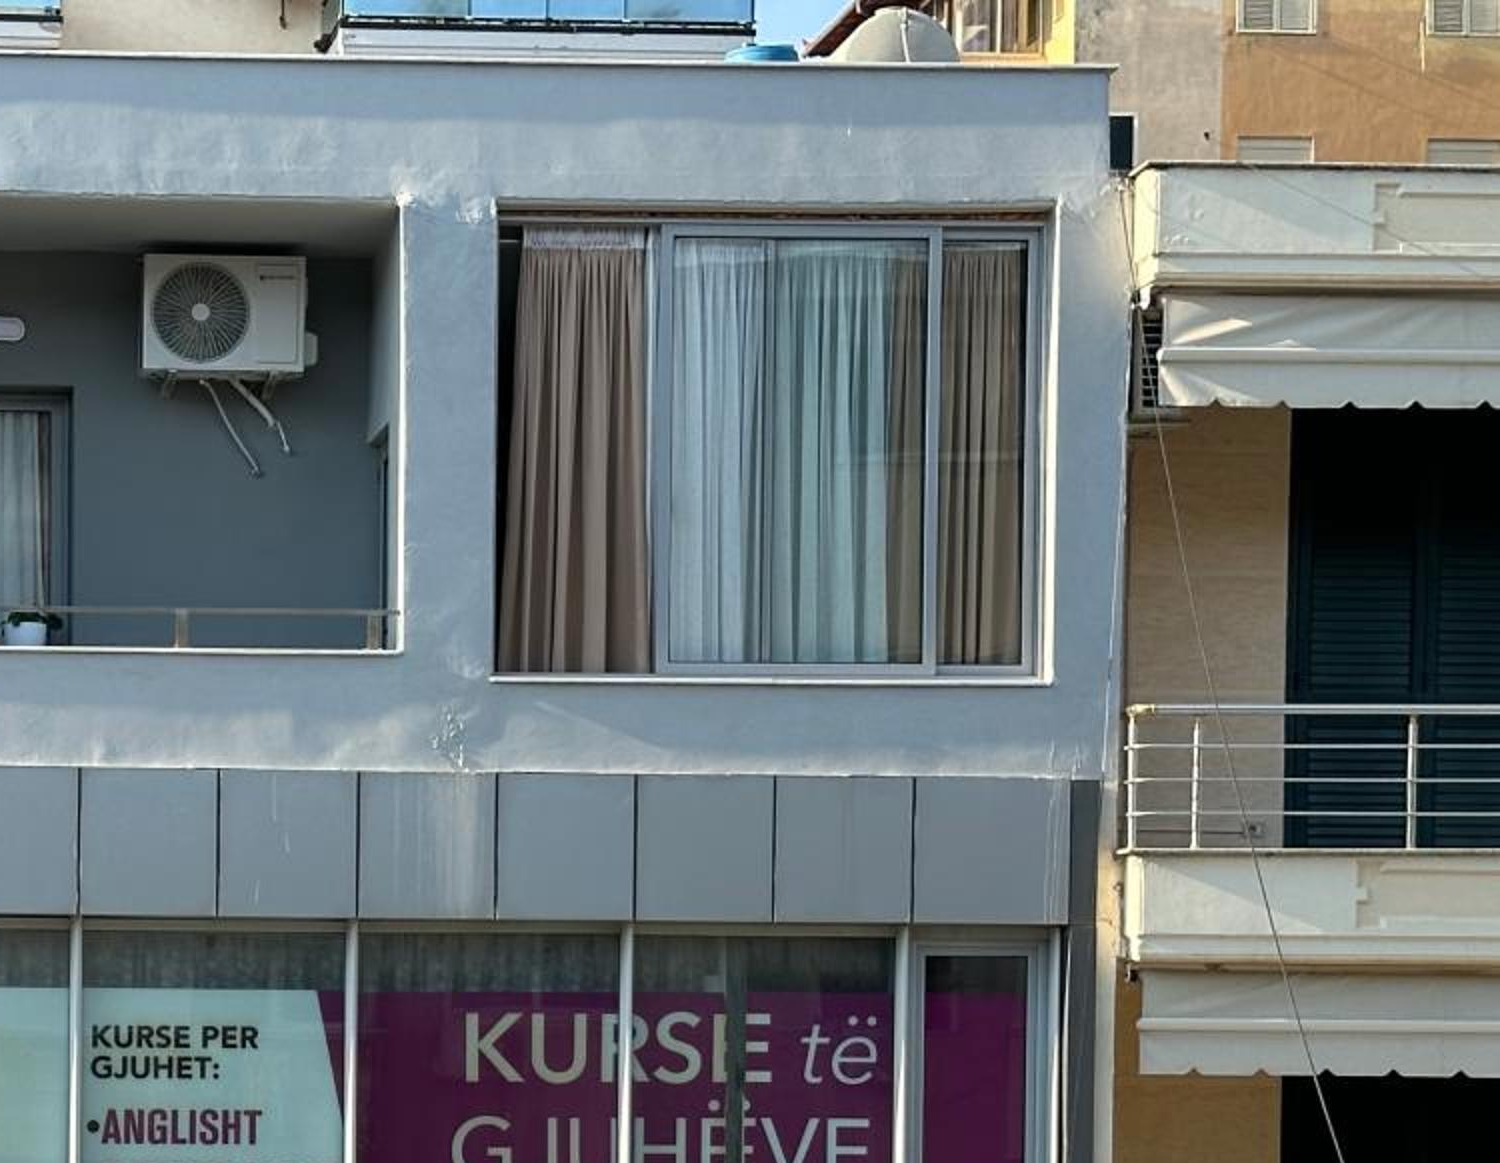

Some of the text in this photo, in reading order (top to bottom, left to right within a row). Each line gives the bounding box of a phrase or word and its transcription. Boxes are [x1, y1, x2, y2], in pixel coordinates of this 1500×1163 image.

[91, 1025, 259, 1050] KURSE PER
[464, 1011, 877, 1085] KURSE të
[91, 1056, 220, 1080] GJUHET:
[101, 1108, 262, 1145] ANGLISHT
